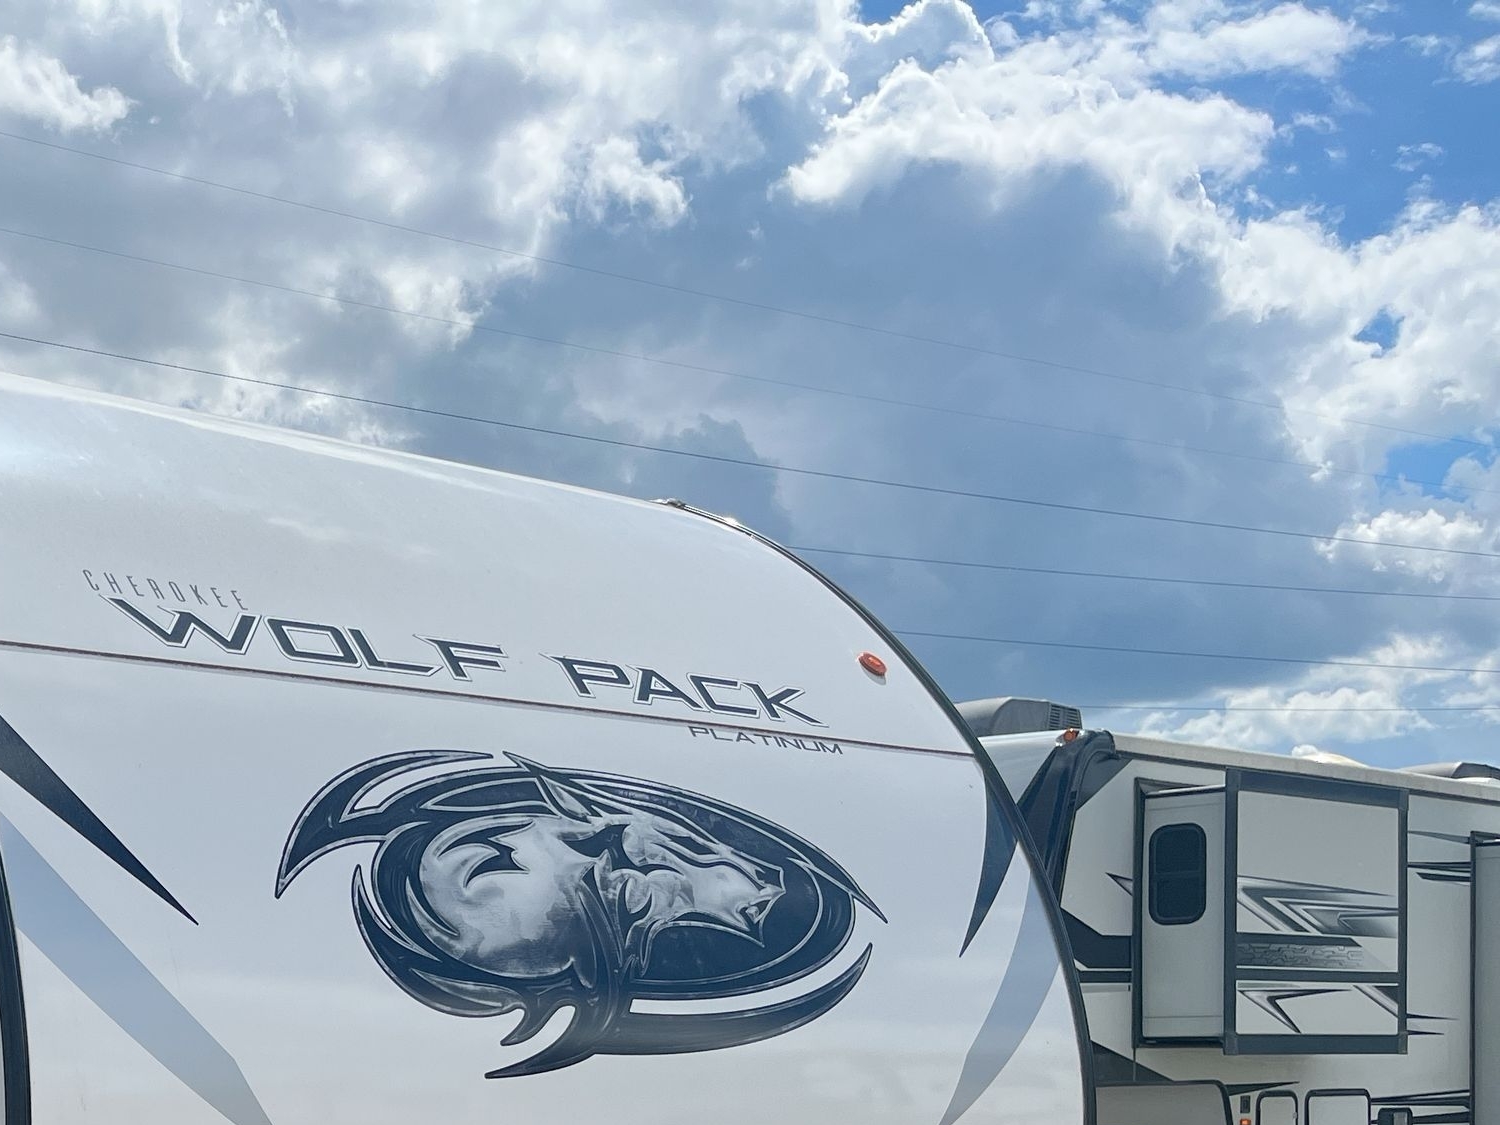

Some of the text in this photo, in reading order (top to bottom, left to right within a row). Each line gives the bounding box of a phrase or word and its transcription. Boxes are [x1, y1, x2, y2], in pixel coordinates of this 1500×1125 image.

[82, 569, 248, 610] CHEROKEE
[99, 594, 829, 727] WOLF PACK
[688, 725, 843, 755] PLATINUM
